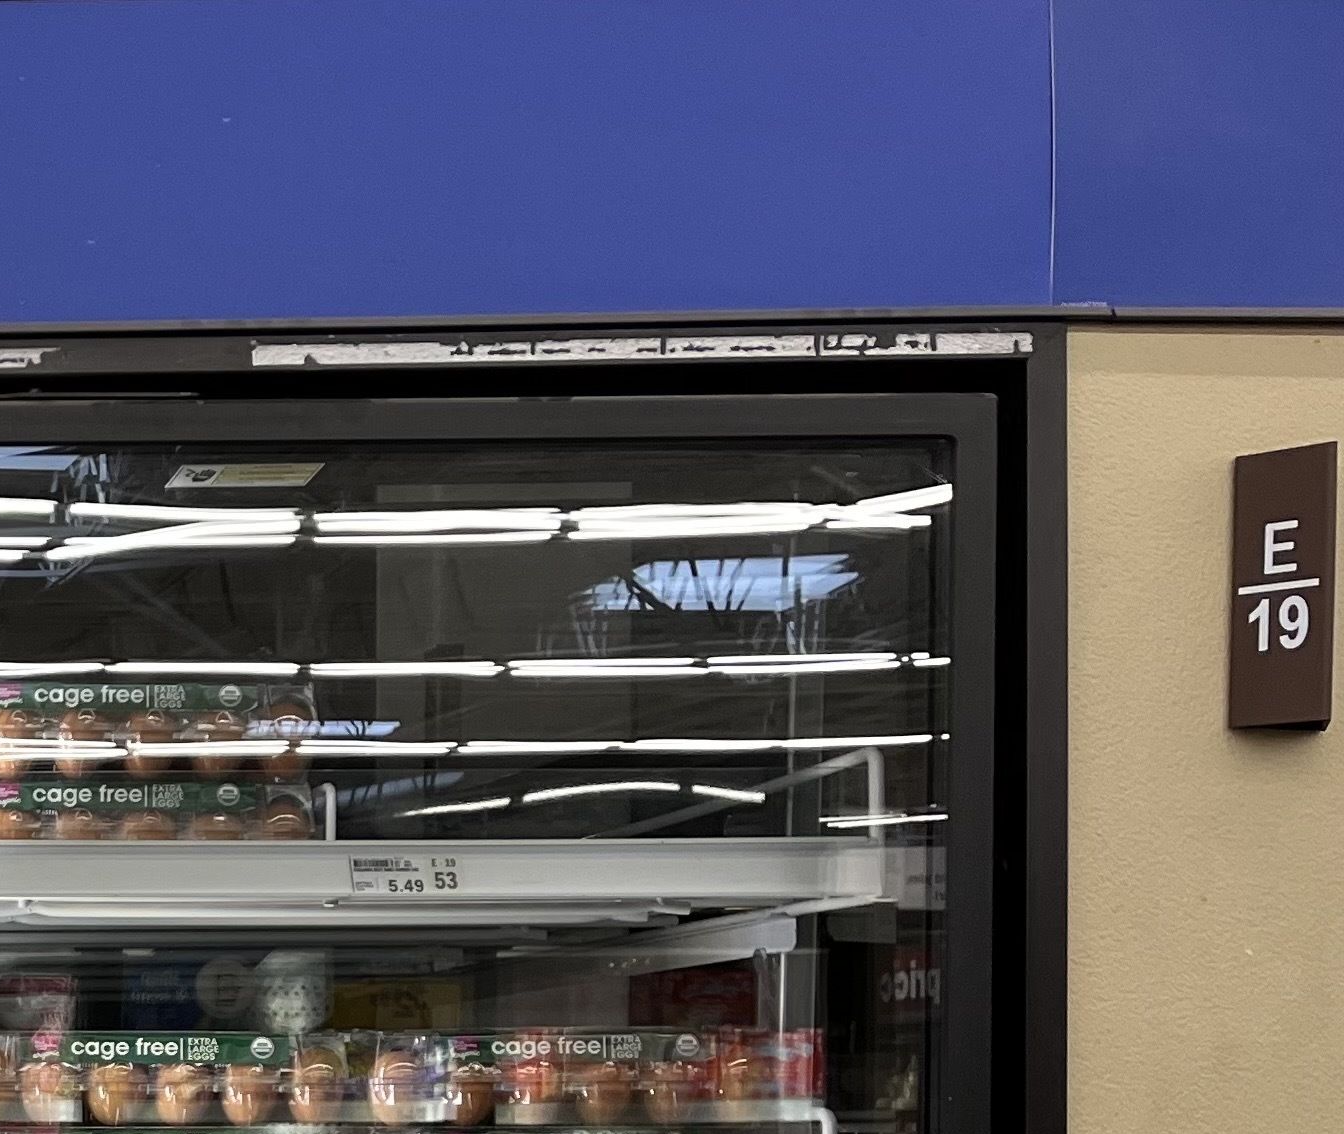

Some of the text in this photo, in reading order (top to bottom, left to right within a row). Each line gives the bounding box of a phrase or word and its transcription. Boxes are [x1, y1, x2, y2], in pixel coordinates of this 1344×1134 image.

[1264, 520, 1298, 576] E
[1248, 594, 1310, 652] 19
[34, 684, 145, 708] cage free
[154, 684, 184, 694] EXTRA
[32, 784, 144, 808] cage free
[152, 784, 183, 792] EXTRA
[388, 880, 424, 892] 5.49
[434, 872, 458, 890] 53
[70, 1038, 178, 1060] cage free
[490, 1036, 601, 1060] cage free
